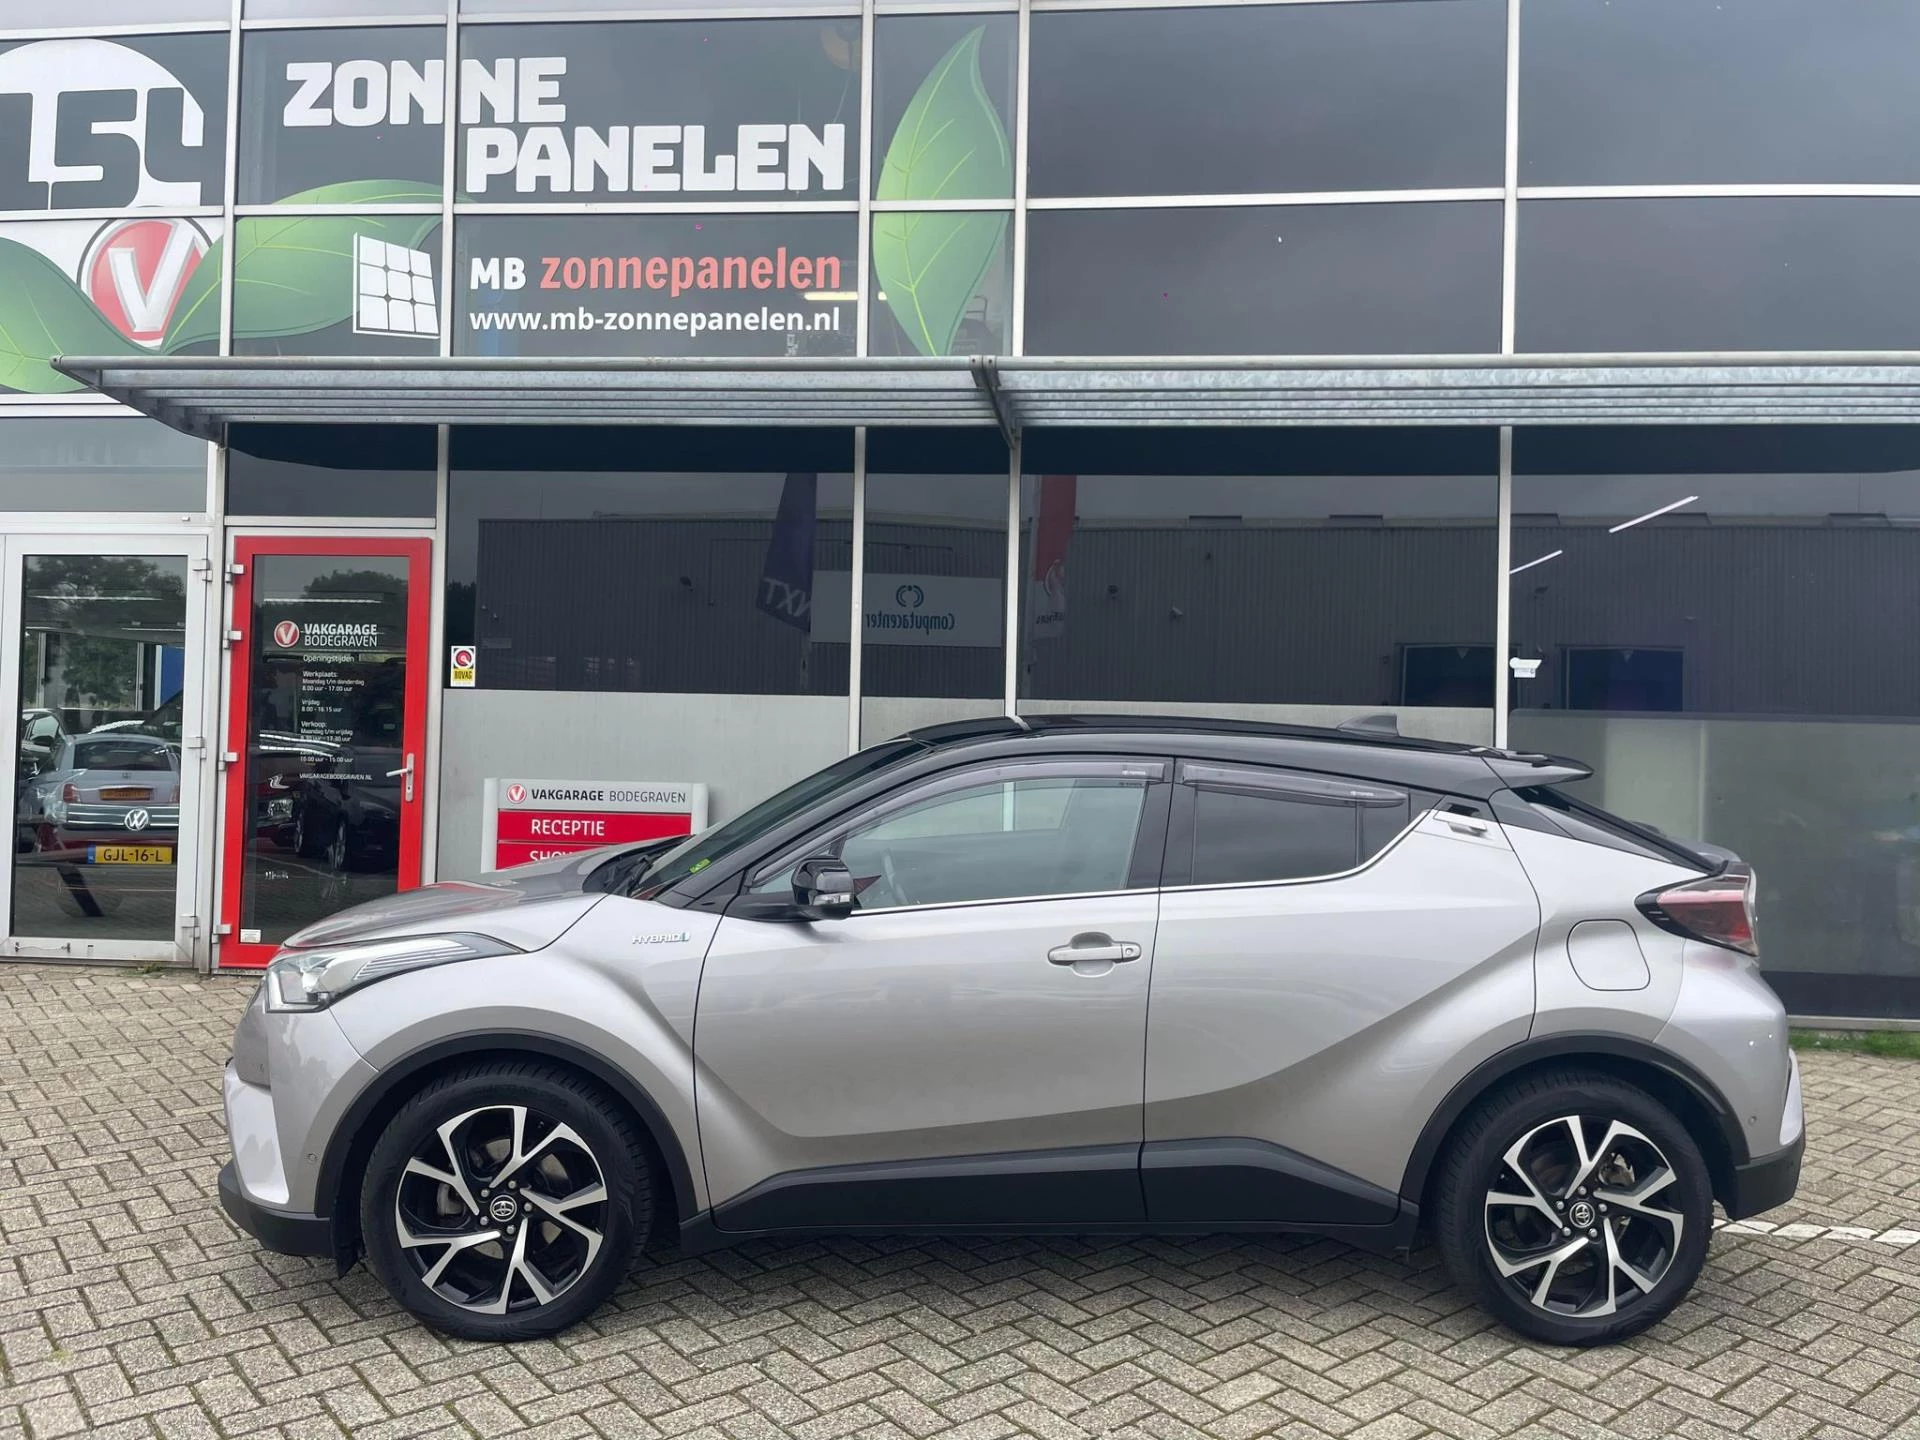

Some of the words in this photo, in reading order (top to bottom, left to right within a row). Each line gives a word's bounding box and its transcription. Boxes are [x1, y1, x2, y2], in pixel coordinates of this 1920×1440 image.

[283, 57, 567, 127] ZONNE
[466, 124, 846, 193] PANELEN
[470, 257, 527, 291] MB
[539, 246, 841, 298] zonnepanelen
[469, 306, 841, 337] www.mb-zonnepanelen.nl
[304, 623, 378, 635] VAKGARAGE
[304, 635, 378, 647] BODEGRAVEN
[531, 788, 604, 801] VAKGARAGE
[609, 790, 687, 804] BODEGRAVEN
[531, 818, 605, 836] RECEPTIE
[103, 848, 163, 863] GJL-16-L
